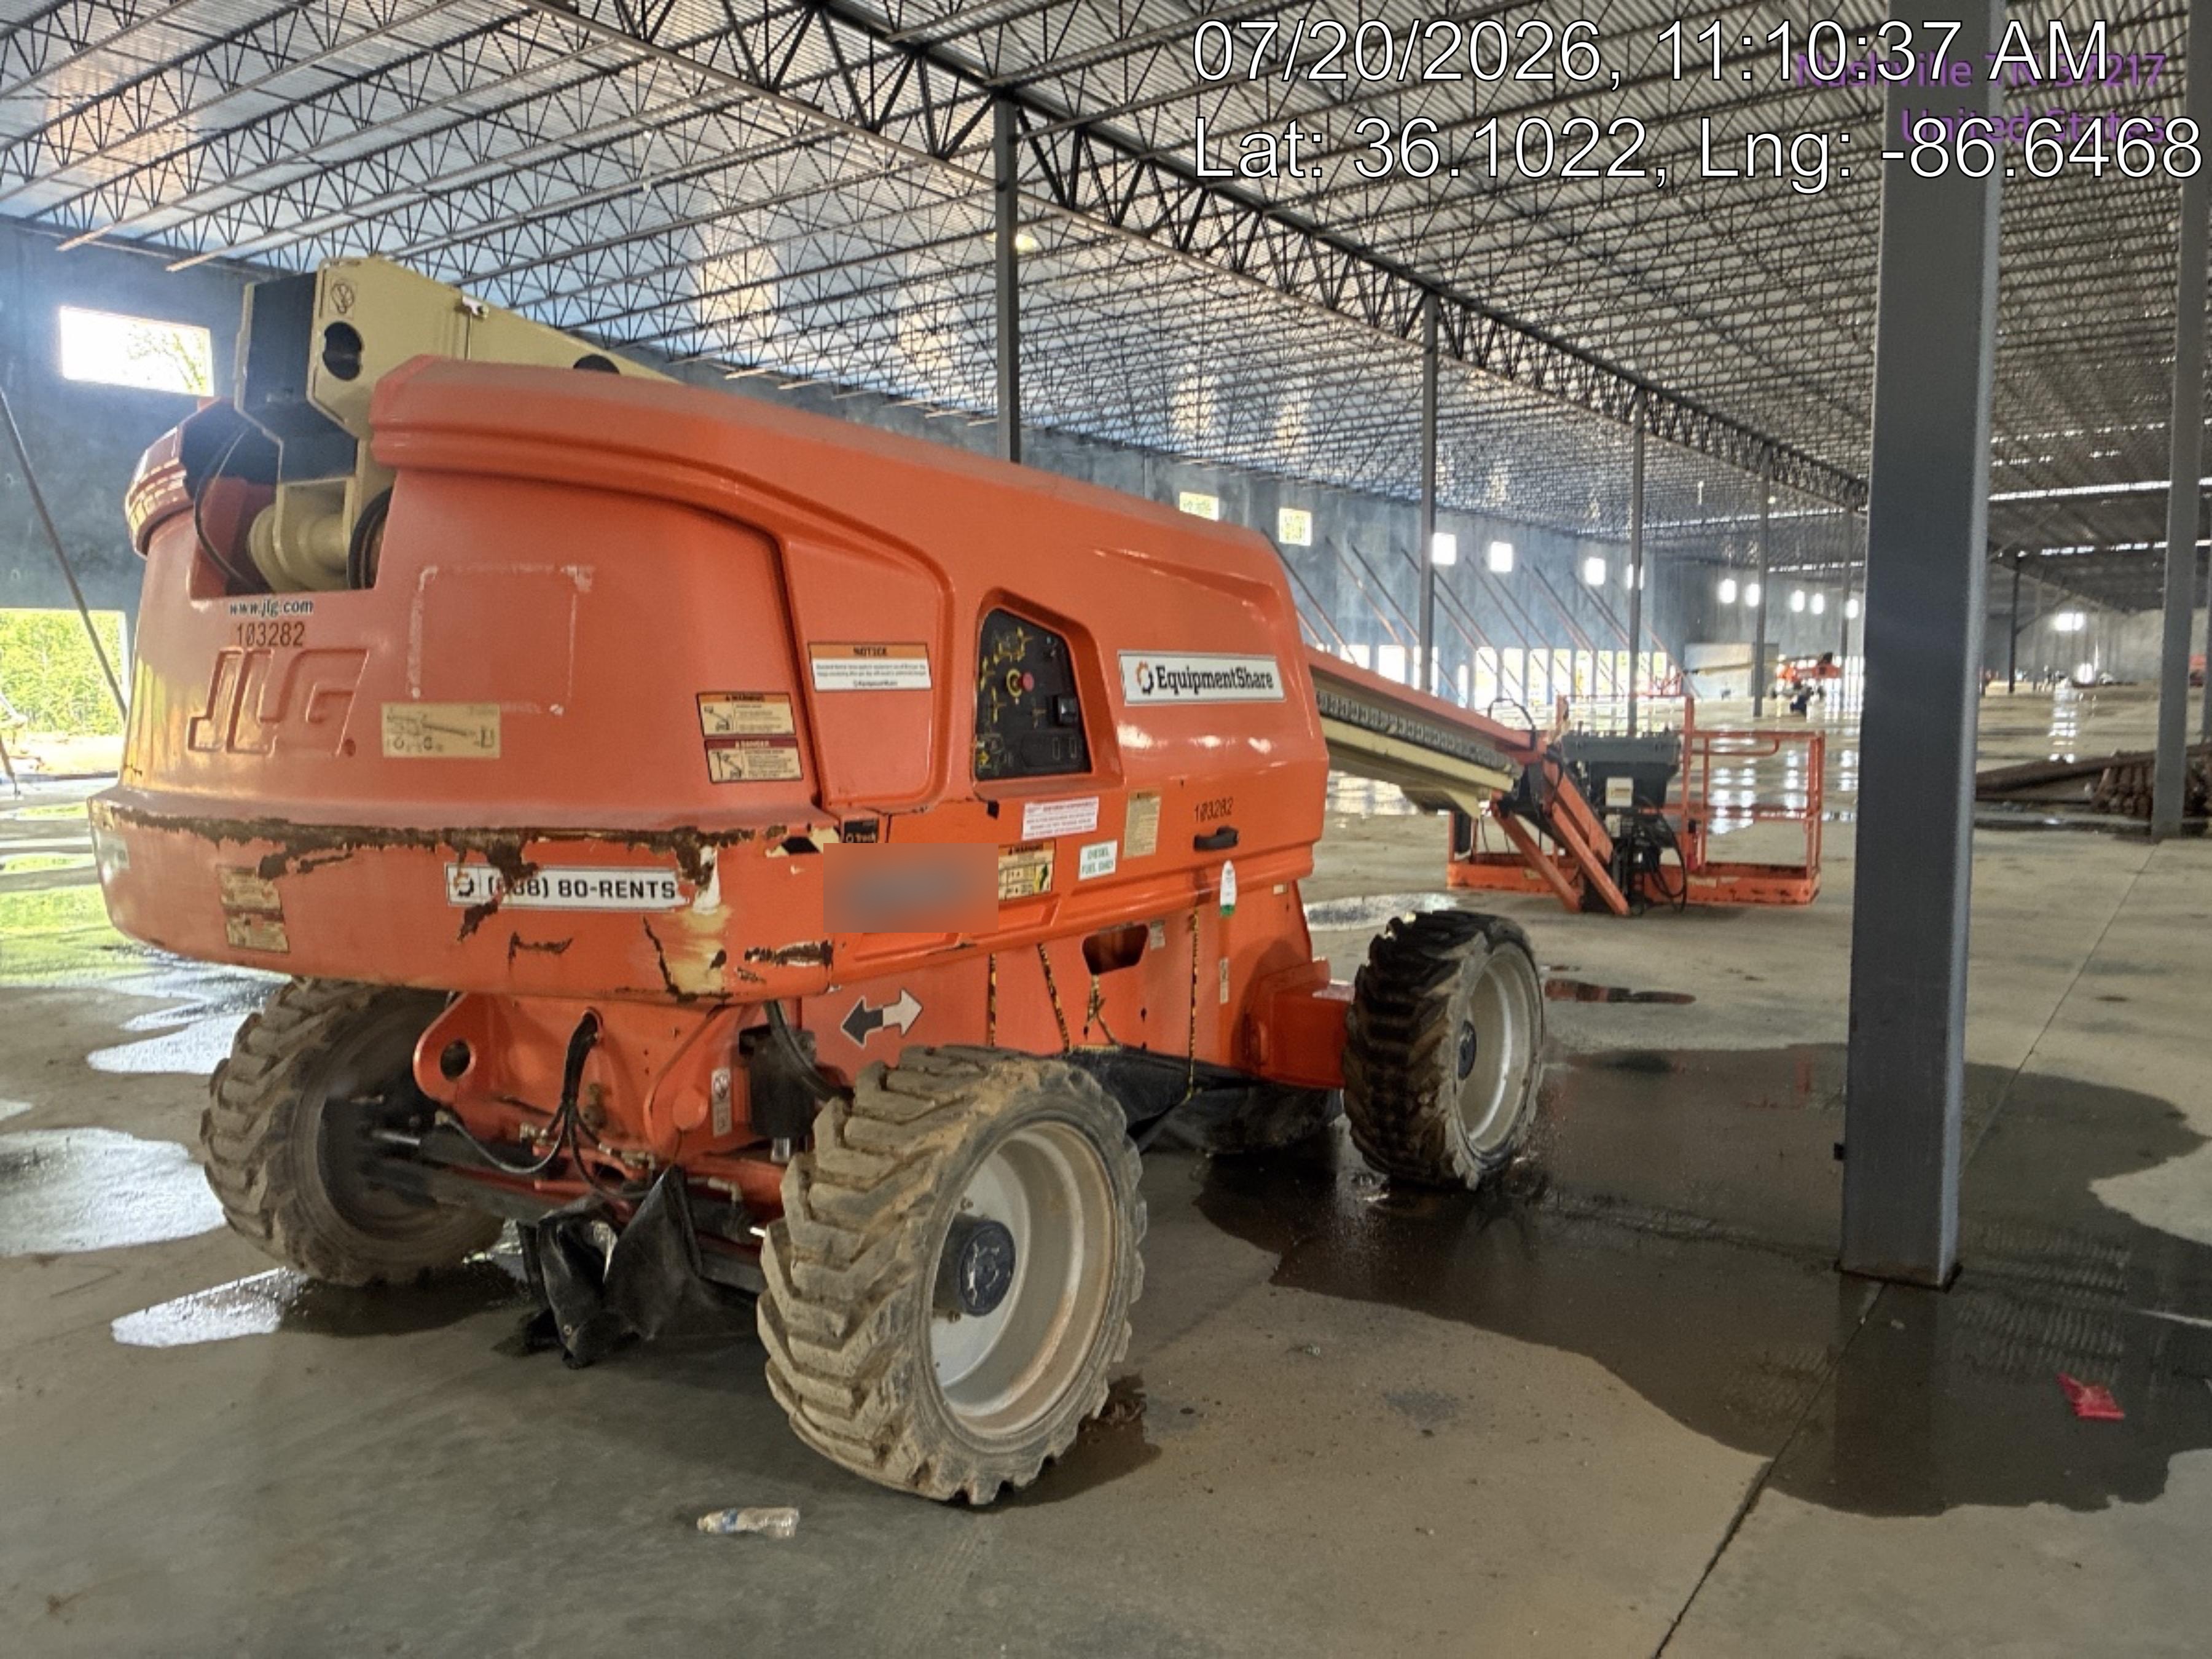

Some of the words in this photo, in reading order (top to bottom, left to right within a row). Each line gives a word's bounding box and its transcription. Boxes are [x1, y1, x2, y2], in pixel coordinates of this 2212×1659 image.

[230, 598, 313, 618] www.jlg.com
[237, 621, 305, 647] 103282
[1155, 664, 1275, 695] EquipmentShare
[187, 648, 369, 757] JLG
[558, 877, 676, 900] 80-RENTS
